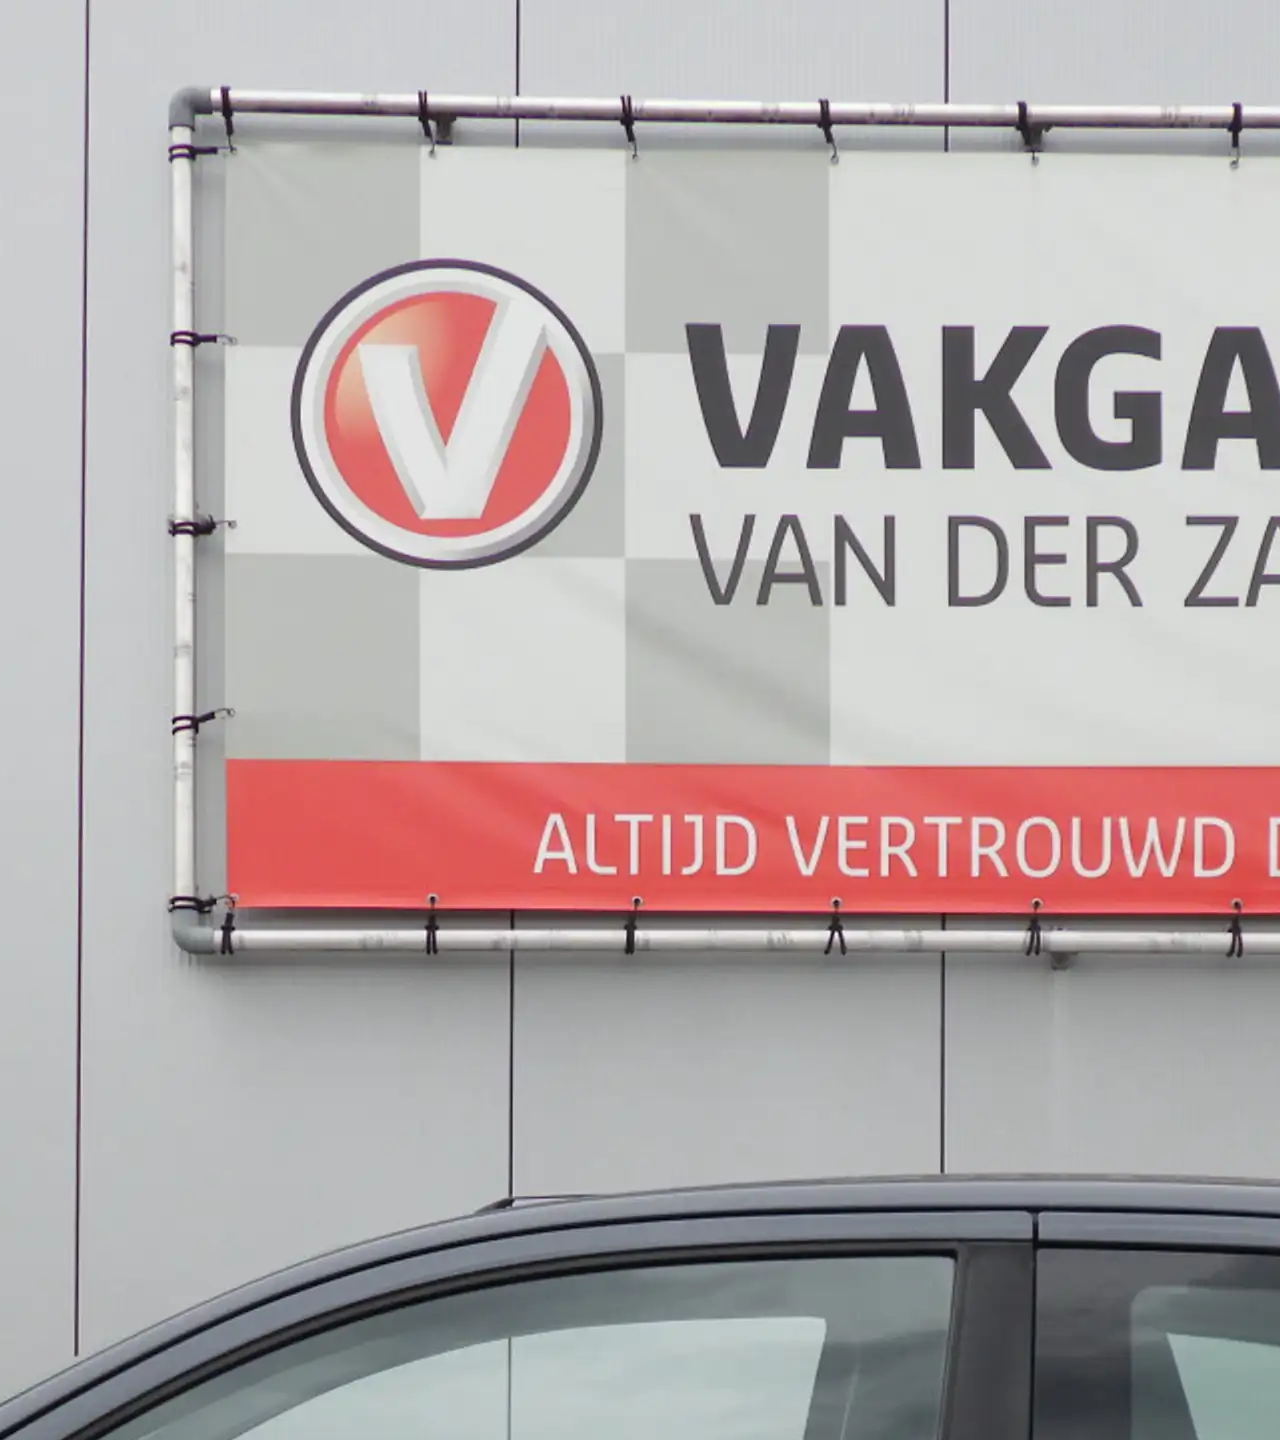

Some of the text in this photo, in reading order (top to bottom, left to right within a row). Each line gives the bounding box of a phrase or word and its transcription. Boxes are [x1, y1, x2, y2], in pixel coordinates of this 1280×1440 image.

[689, 512, 896, 608] VAN
[947, 513, 1143, 608] DER
[532, 812, 758, 878] ALTIJD
[784, 813, 1236, 879] VERTROUWD
